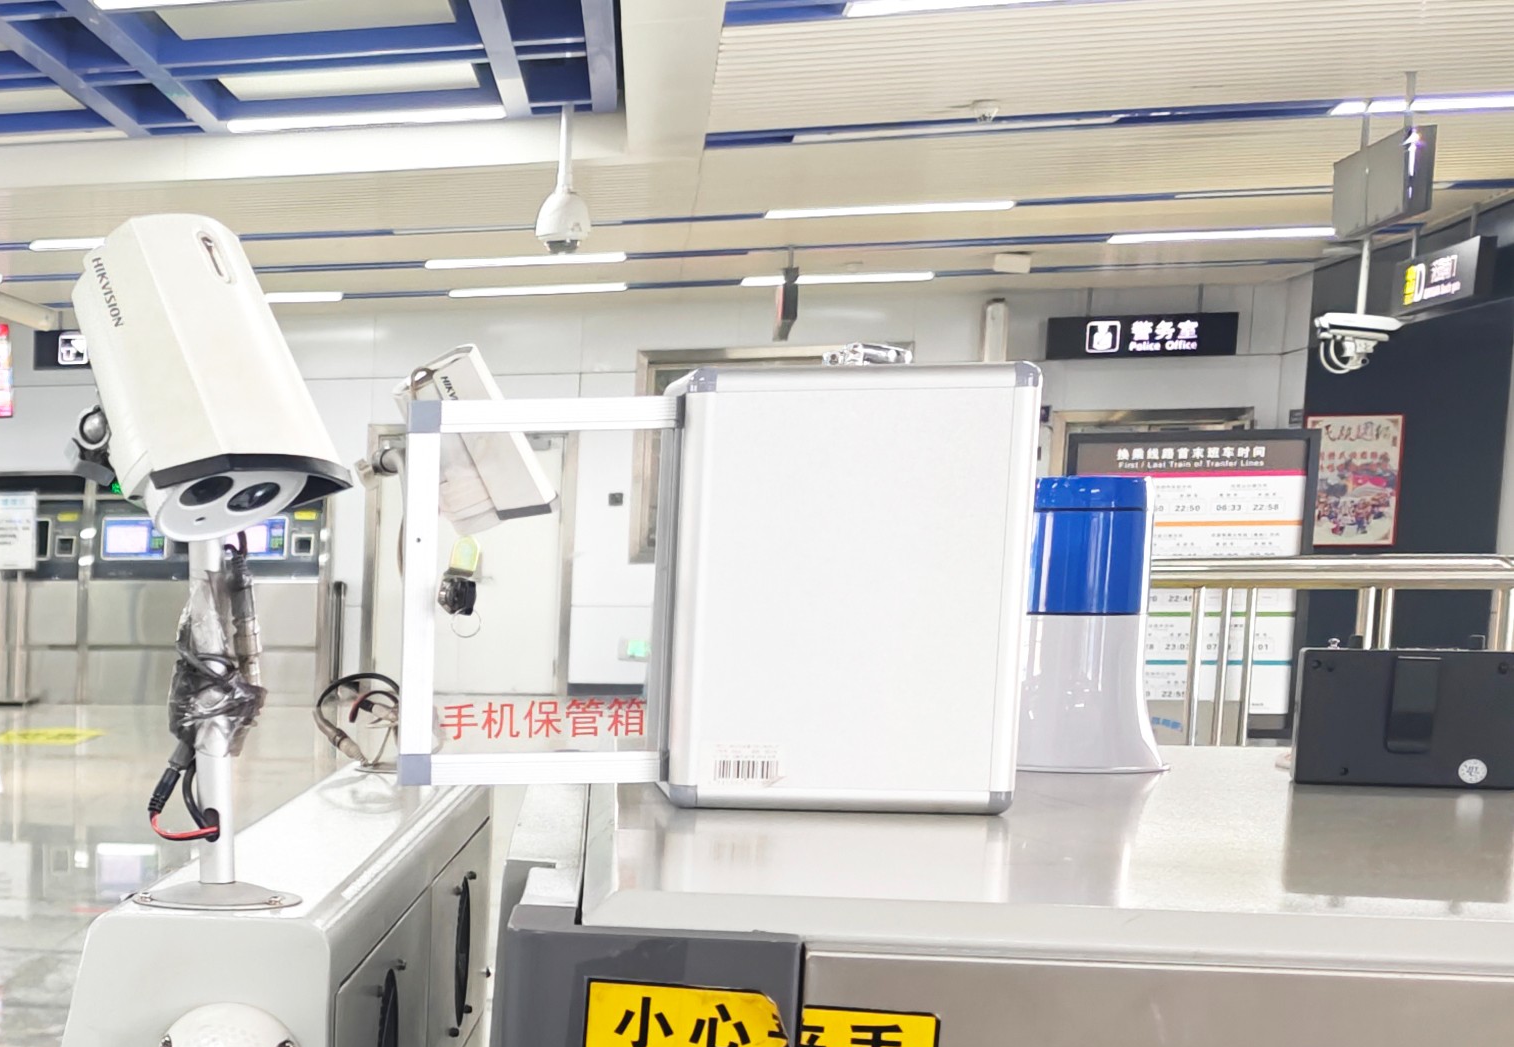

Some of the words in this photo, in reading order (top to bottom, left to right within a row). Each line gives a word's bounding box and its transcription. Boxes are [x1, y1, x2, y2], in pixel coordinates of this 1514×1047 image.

[92, 257, 123, 328] HIKVISION
[1130, 319, 1199, 340] 警务室
[1129, 340, 1161, 351] Police
[1165, 339, 1198, 350] Office
[1116, 446, 1266, 460] 换乘线路首末班车时间
[1118, 461, 1138, 469] First
[1147, 460, 1166, 468] Last
[1169, 460, 1191, 468] Train
[1193, 460, 1203, 468] of
[1240, 459, 1264, 467] Lines
[1175, 504, 1201, 512] 22:50
[440, 698, 647, 740] 手机保管箱
